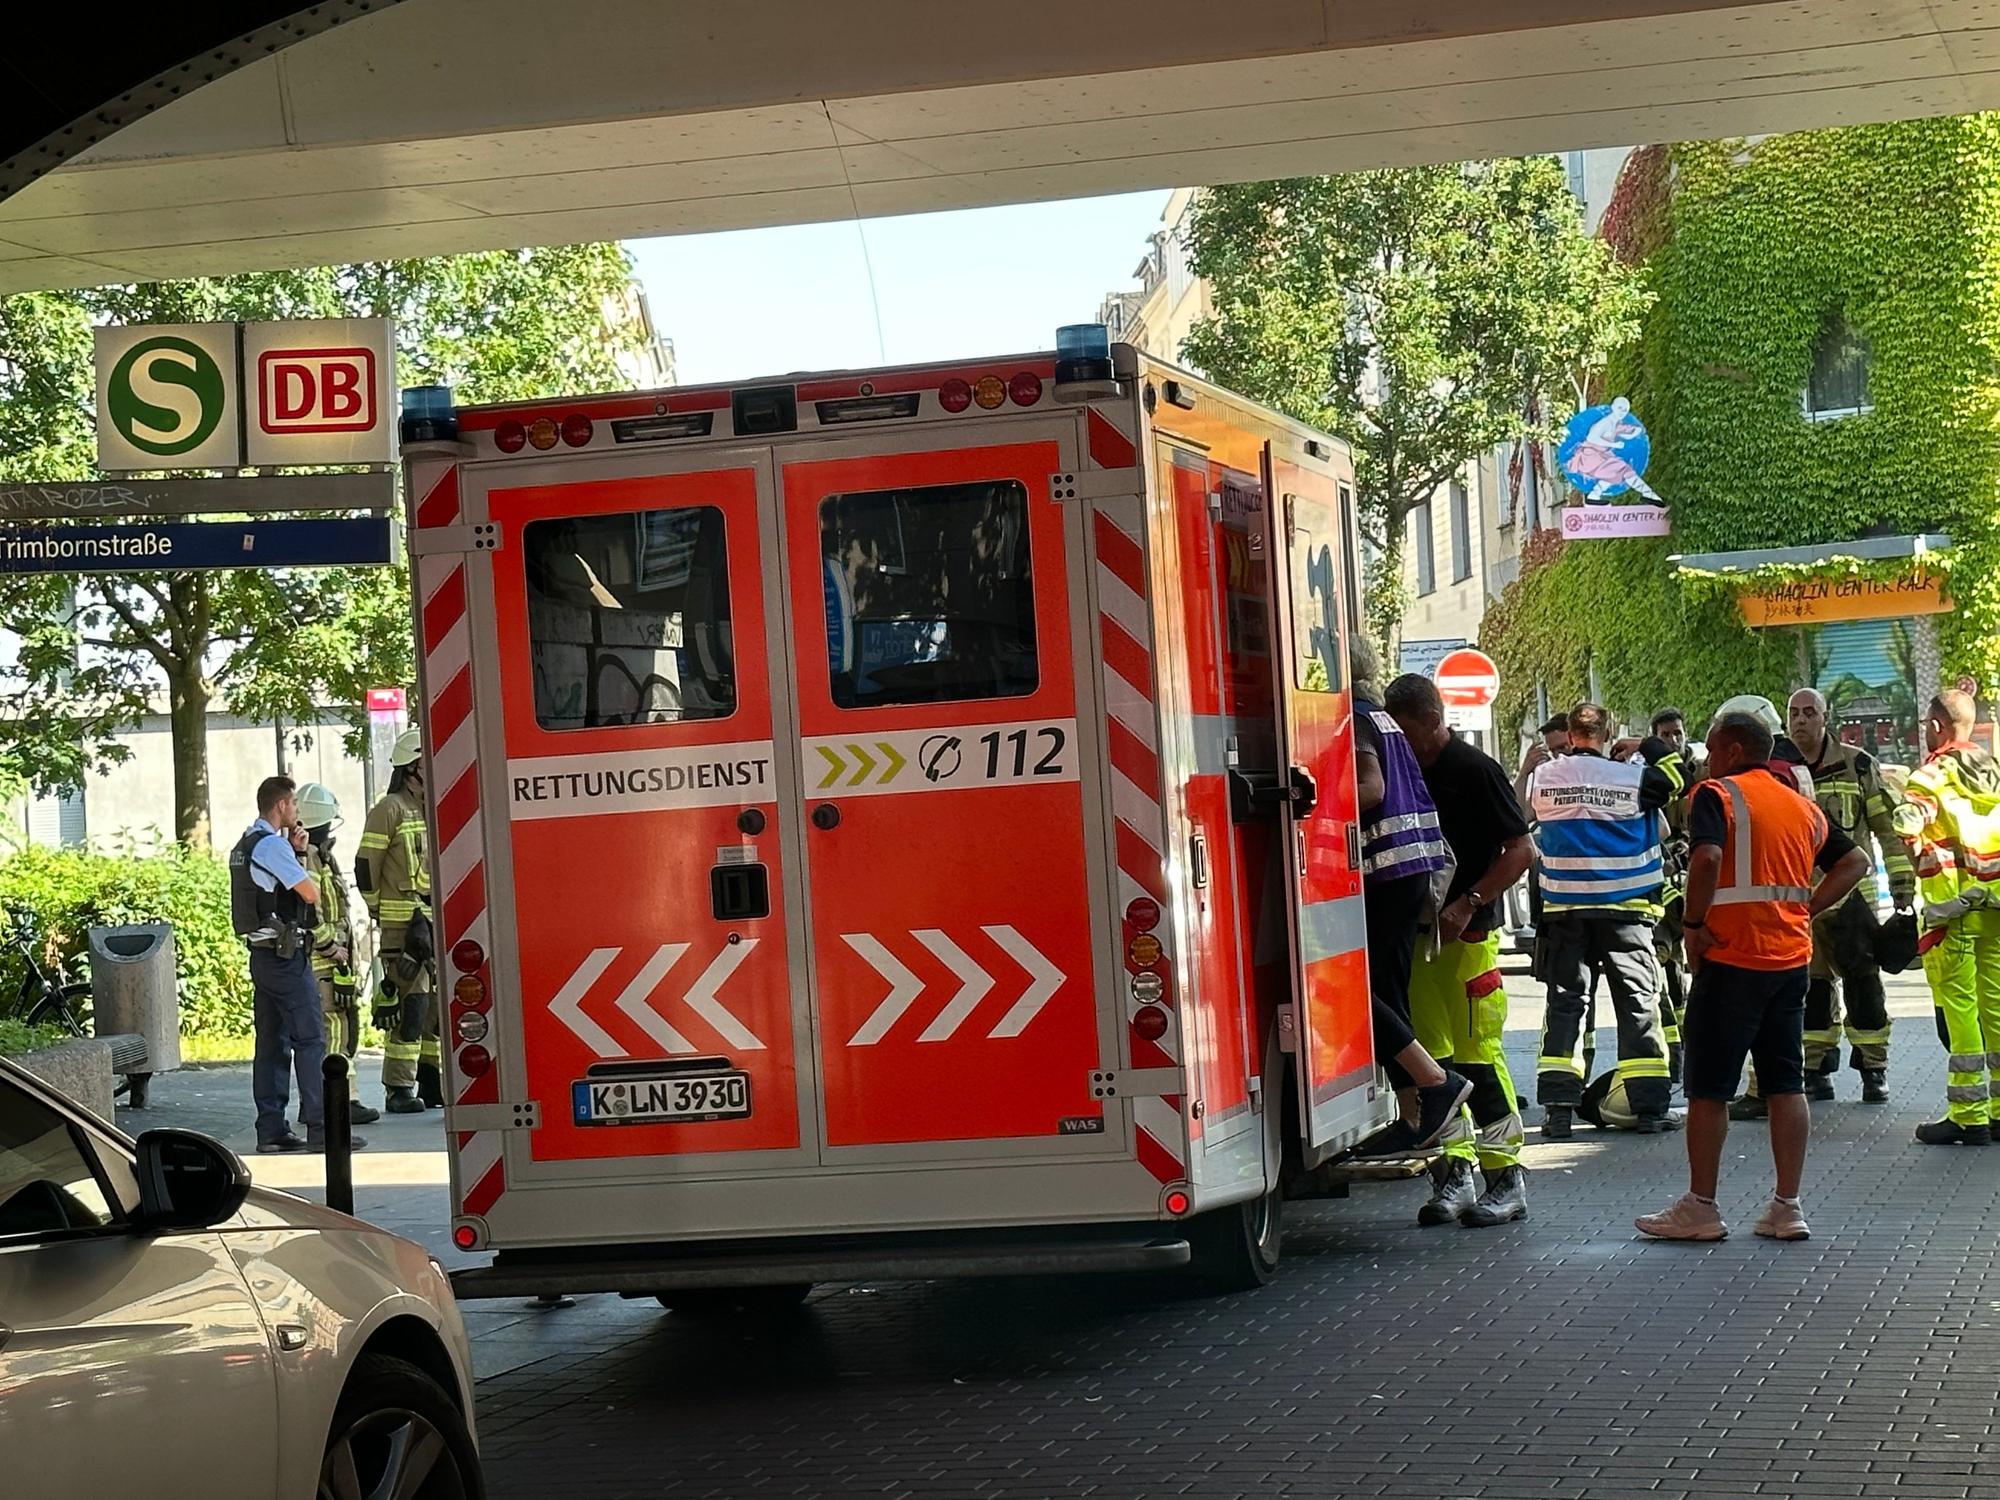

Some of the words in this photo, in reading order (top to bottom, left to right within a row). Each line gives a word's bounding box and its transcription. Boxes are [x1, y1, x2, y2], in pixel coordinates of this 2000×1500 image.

[129, 348, 203, 444] S
[274, 362, 363, 420] DB
[1622, 511, 1655, 523] CENTER
[0, 532, 172, 559] Trimbornstraße
[1897, 575, 1934, 593] KALK
[980, 727, 1065, 778] 112
[514, 760, 768, 801] RETTUNGSDIENST
[674, 1079, 744, 1112] 3930
[1065, 1119, 1097, 1130] WAS
